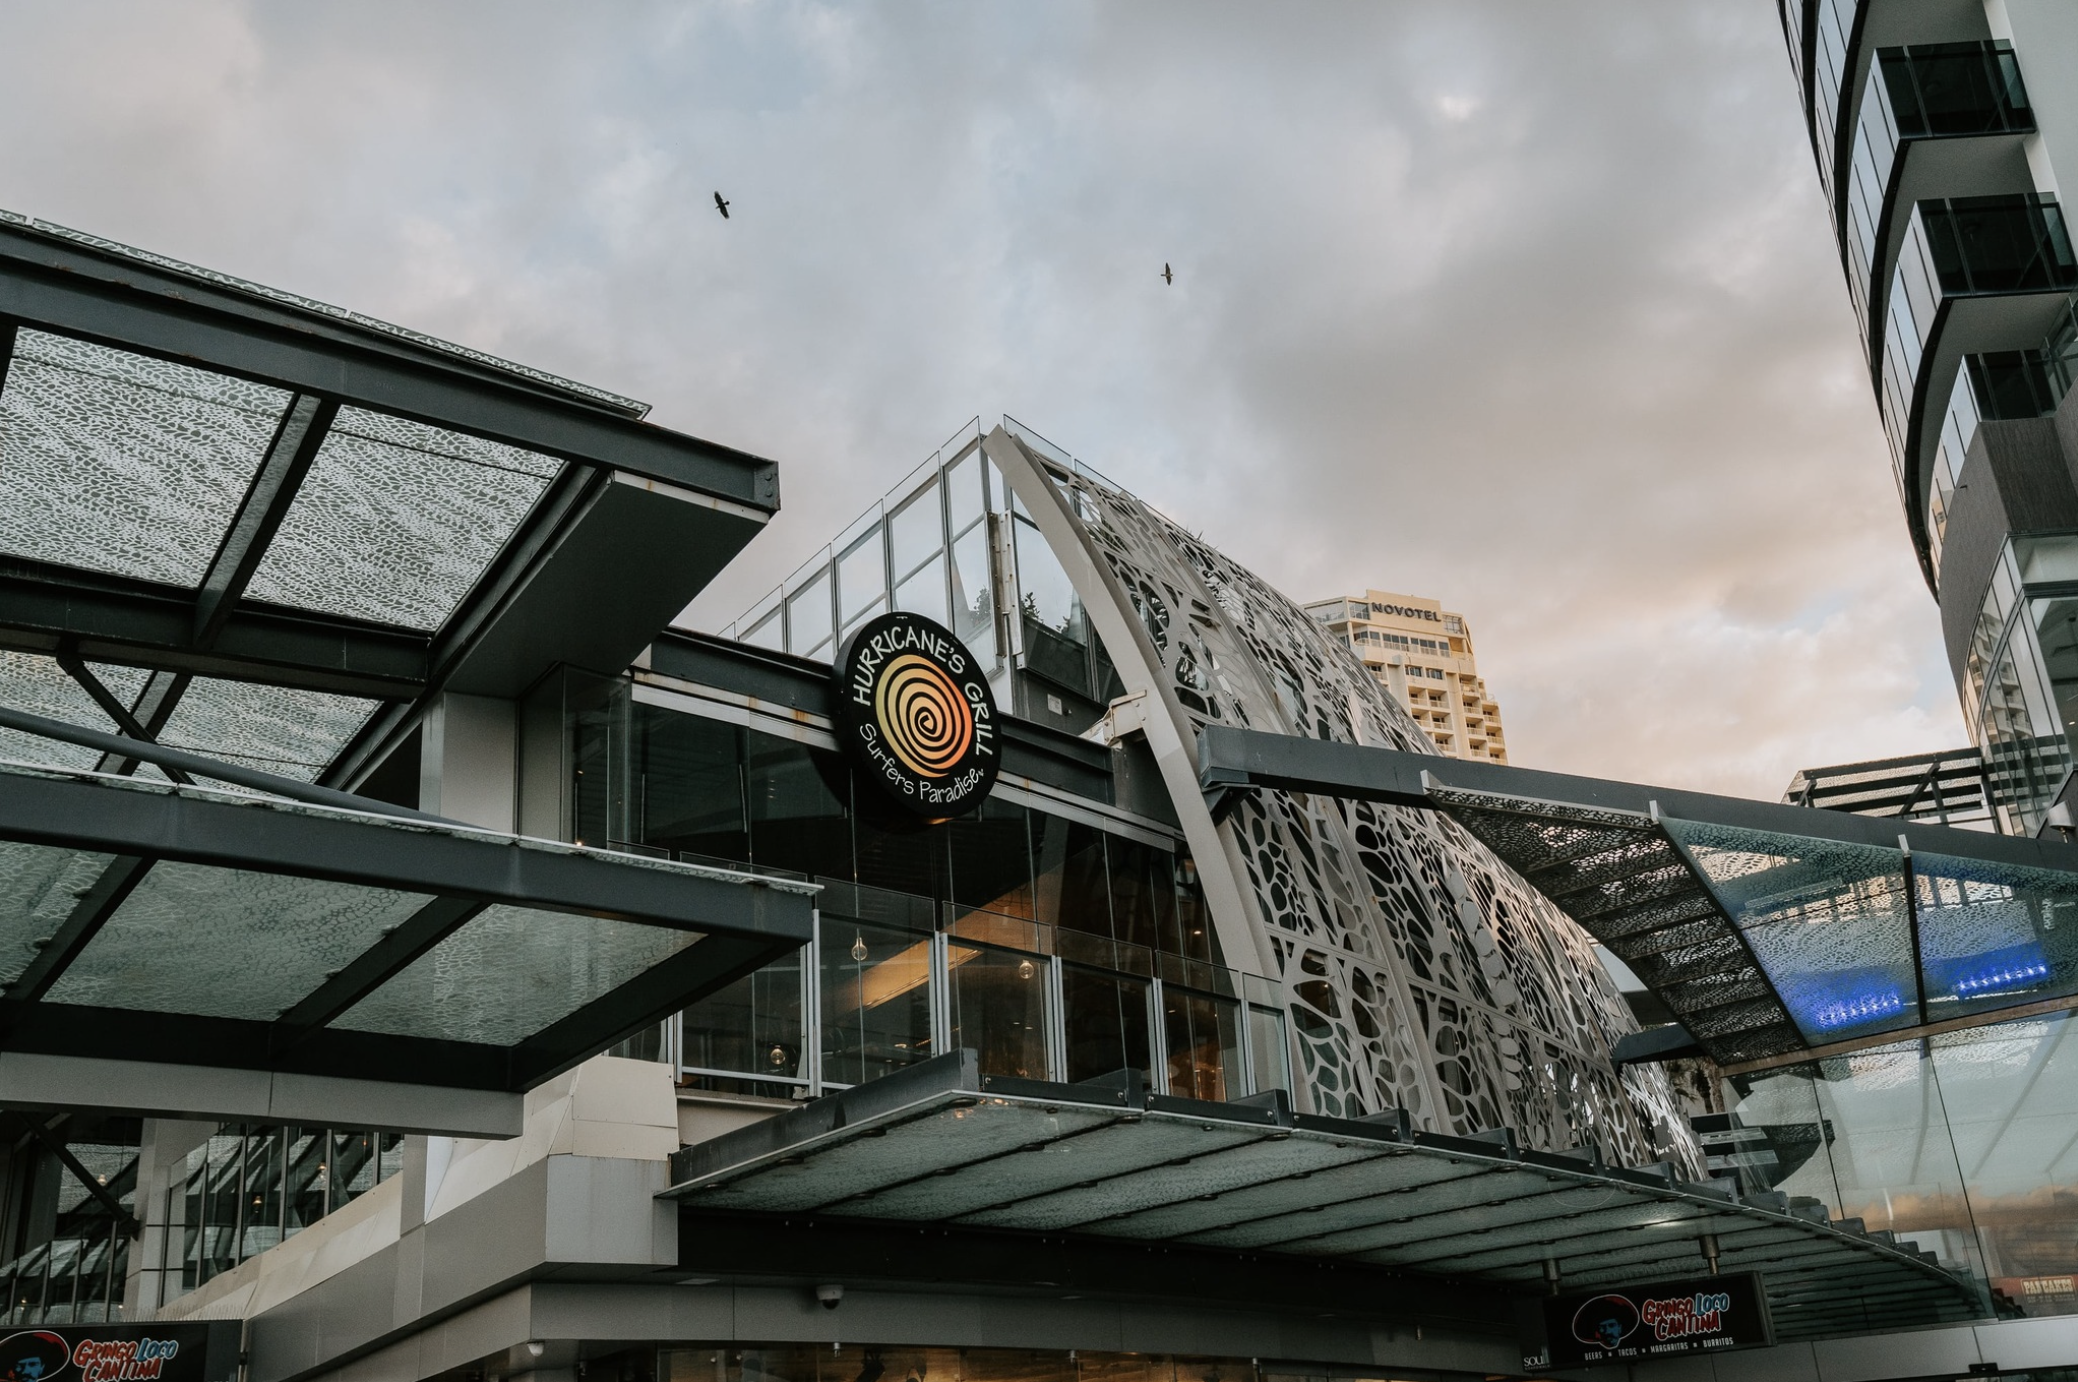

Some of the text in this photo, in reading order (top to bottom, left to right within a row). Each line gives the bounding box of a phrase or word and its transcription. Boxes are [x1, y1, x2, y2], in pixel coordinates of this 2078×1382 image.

[1371, 602, 1441, 622] NOVOTEL
[853, 626, 993, 756] HURRICANE'S GRILL
[859, 723, 979, 803] Surfers Paradise
[1642, 1292, 1730, 1325] GRINGO LOCO
[1655, 1310, 1721, 1341] CANTINA
[73, 1338, 179, 1367] GRINGO LOCO
[1584, 1336, 1734, 1361] BEERS TACOS MARGARITAS BURRITOS
[83, 1358, 162, 1382] CANTINA
